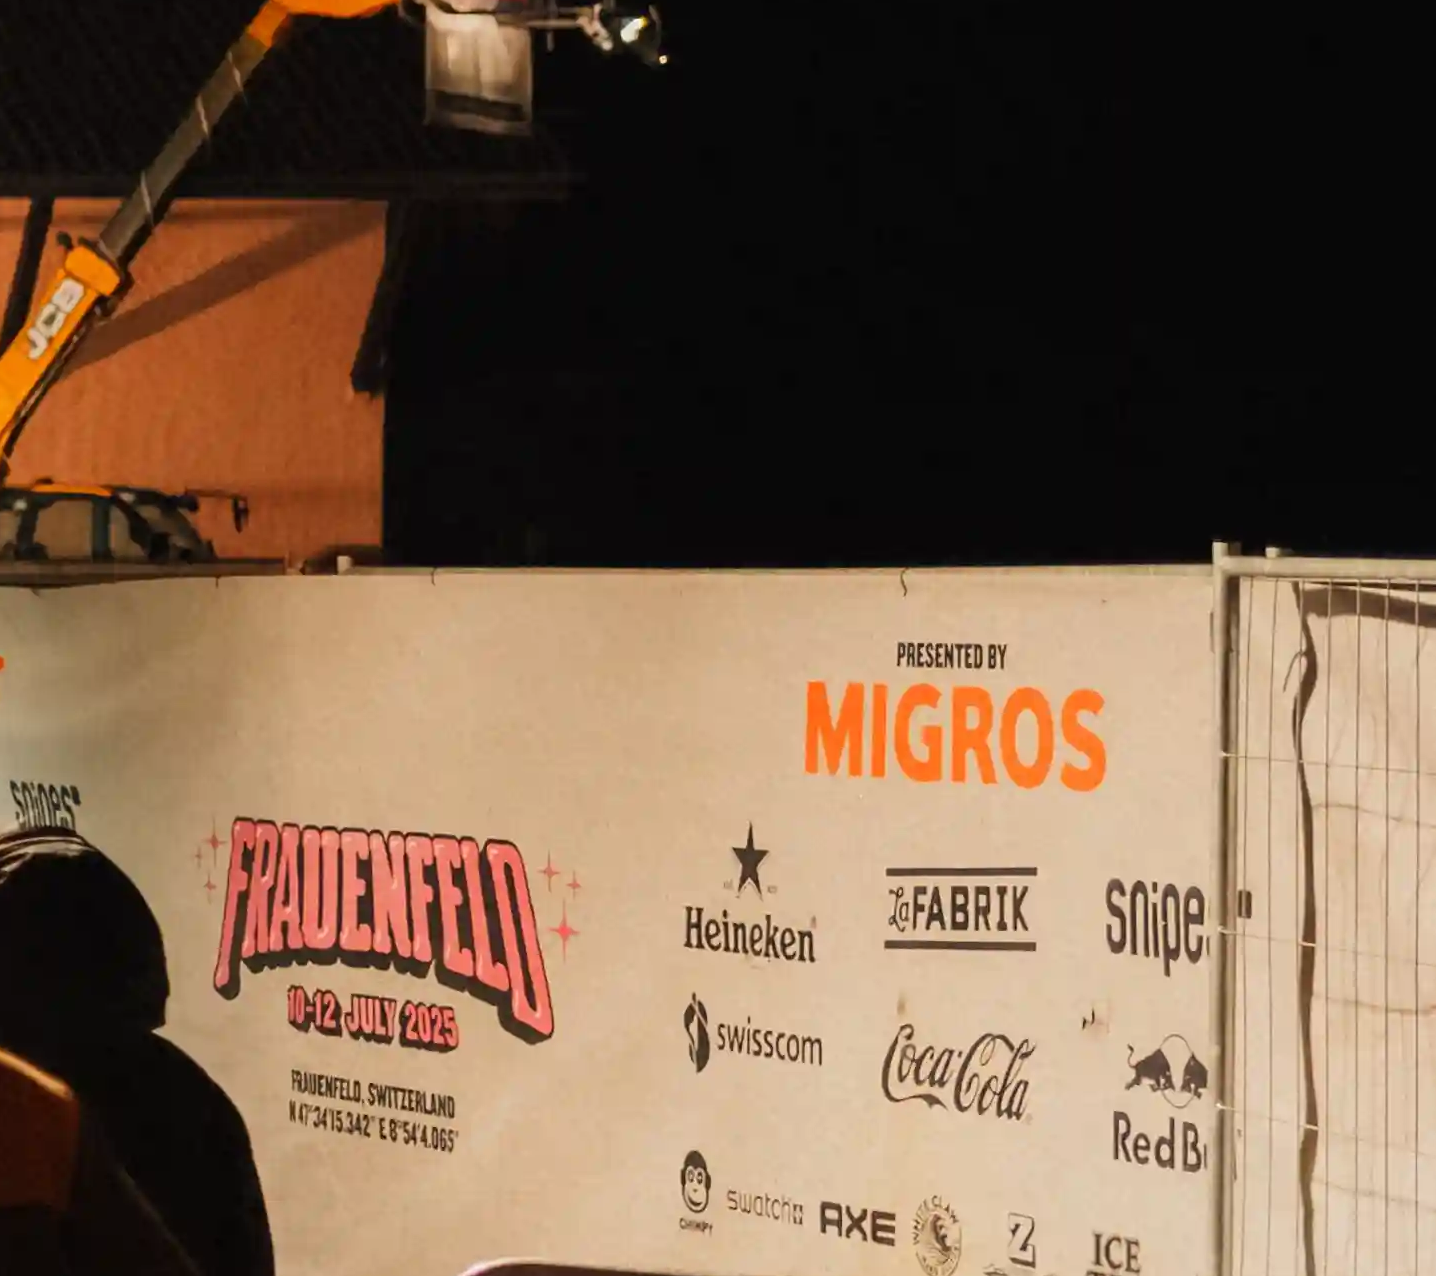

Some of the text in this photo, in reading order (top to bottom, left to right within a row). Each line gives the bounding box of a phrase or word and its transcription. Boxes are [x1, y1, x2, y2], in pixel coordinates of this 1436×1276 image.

[896, 641, 1008, 671] PRESENTED BY
[803, 679, 1108, 793] MIGROS
[213, 816, 556, 1046] FRAUENFELD
[682, 905, 817, 963] Heineken
[887, 885, 1030, 934] La FABRIK
[1105, 877, 1211, 978] snipe
[287, 984, 460, 1054] 10-12 JULY 2025
[716, 1014, 823, 1068] swisscom
[291, 1069, 456, 1120] FRAUENFELD, SWITZERLAND
[880, 1022, 1036, 1122] Coca-Cola
[378, 1117, 388, 1141] E
[1112, 1110, 1176, 1171] Red
[726, 1188, 793, 1224] swatch
[819, 1200, 896, 1247] AXE
[1007, 1212, 1037, 1268] Z
[1092, 1231, 1141, 1273] ICE
